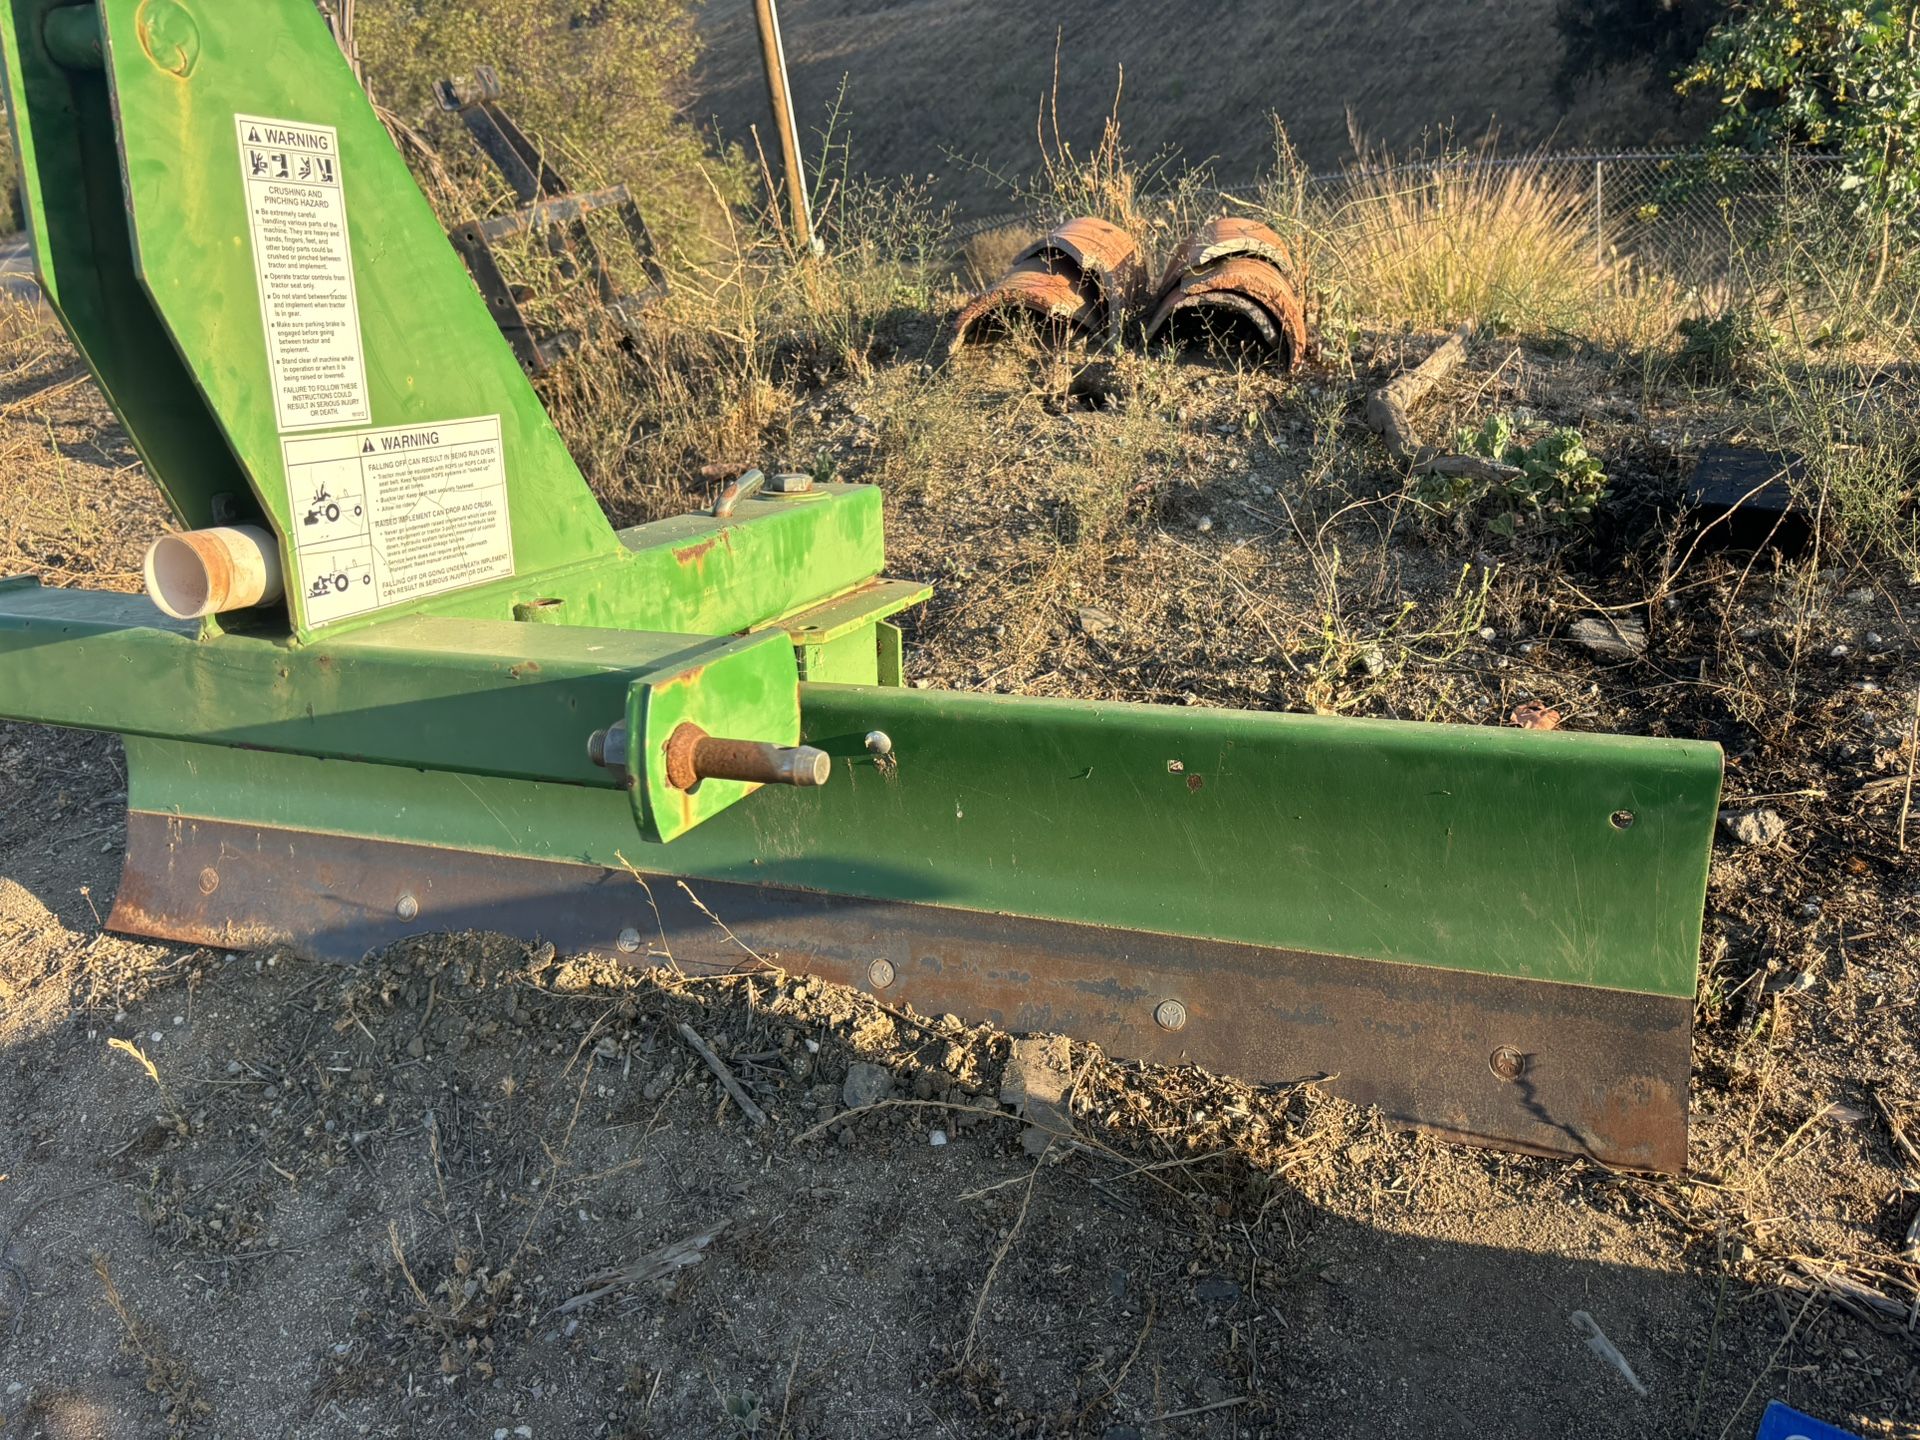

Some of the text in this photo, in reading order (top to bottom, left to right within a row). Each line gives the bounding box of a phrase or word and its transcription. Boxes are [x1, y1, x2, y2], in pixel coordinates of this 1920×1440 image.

[265, 128, 328, 149] WARNING
[269, 186, 306, 196] CRUSHING
[265, 196, 329, 208] PINCHING HAZARD
[270, 210, 296, 218] extremely
[262, 218, 286, 226] handling
[290, 228, 302, 236] They
[285, 236, 305, 244] fingers,
[282, 245, 295, 253] body
[290, 365, 314, 373] operation
[293, 392, 332, 401] INSTRUCTIONS
[288, 402, 308, 410] RESULT
[317, 400, 340, 408] SERIOUS
[381, 432, 439, 450] WARNING
[368, 461, 393, 471] FALLING
[395, 459, 407, 467] OFF
[422, 454, 442, 463] RESULT
[451, 452, 467, 460] BEING
[375, 519, 397, 528] RAISED
[398, 512, 431, 526] IMPLEMENT
[433, 509, 444, 517] CAN
[382, 578, 405, 588] FALLING
[428, 569, 445, 578] GOING
[446, 561, 480, 573] UNDERNEATH
[481, 554, 507, 565] IMPLEMENT
[383, 588, 396, 597] CAN
[397, 583, 417, 594] RESULT
[426, 575, 448, 586] SERIOUS
[449, 572, 467, 580] INJURY
